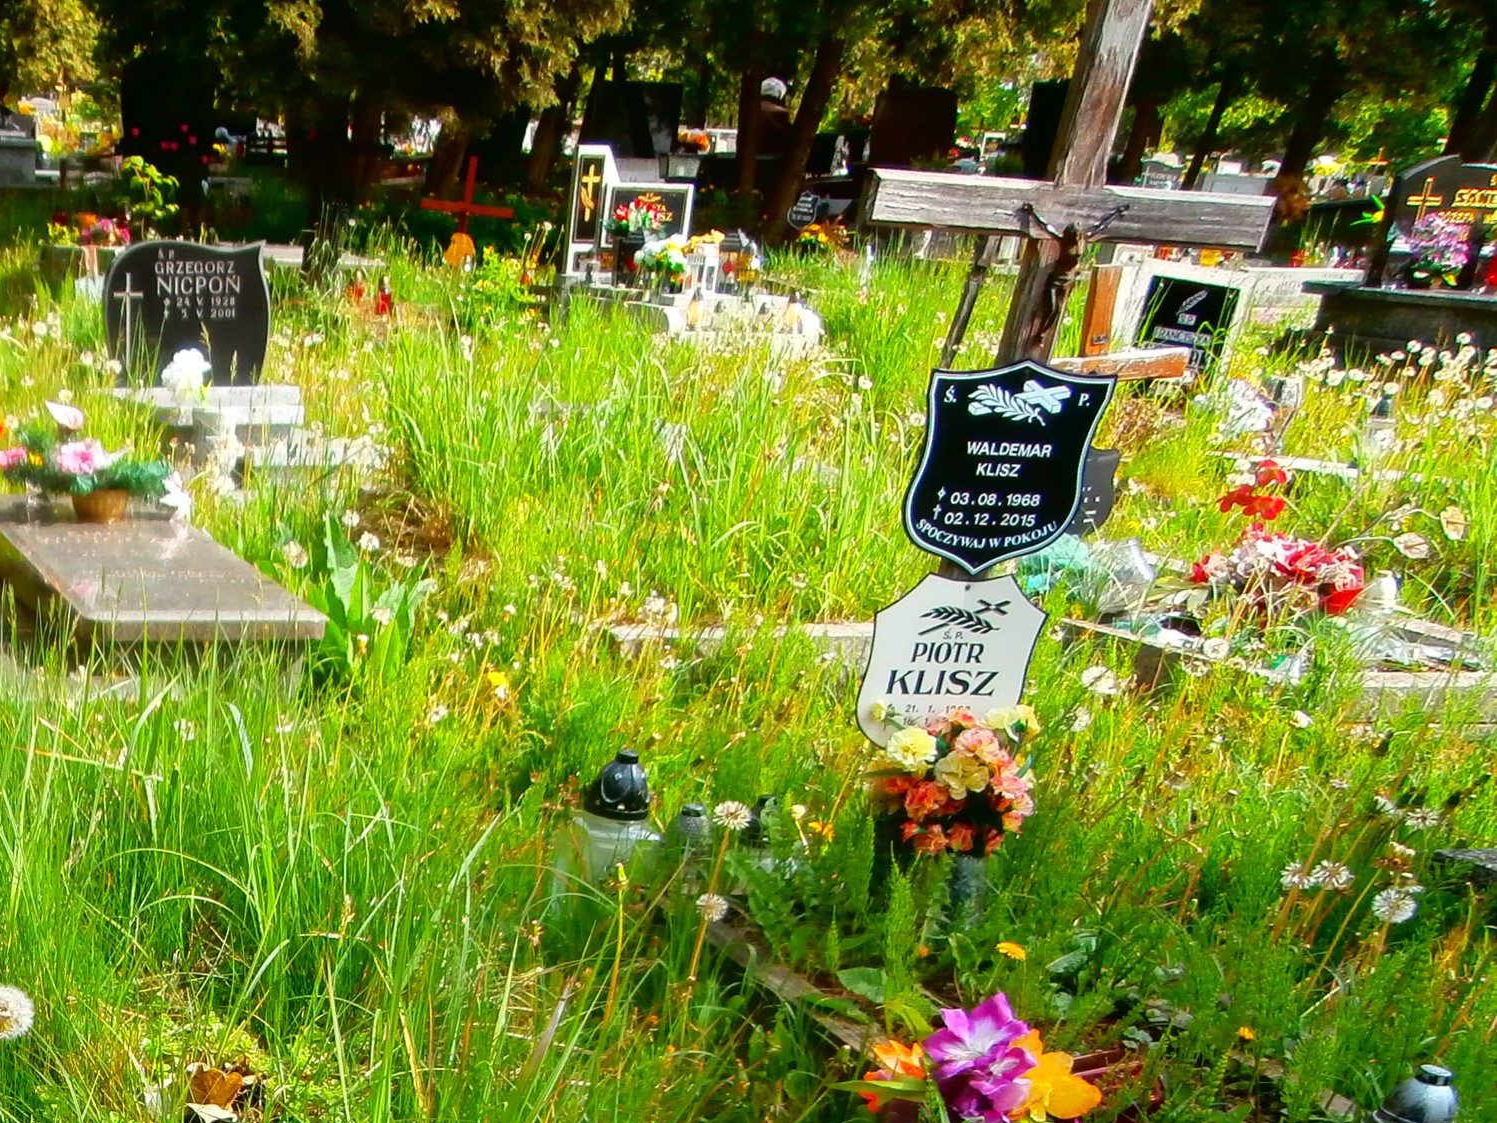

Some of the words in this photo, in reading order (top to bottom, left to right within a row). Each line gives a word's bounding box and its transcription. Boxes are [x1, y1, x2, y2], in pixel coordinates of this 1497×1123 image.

[154, 260, 235, 275] GRZEGORZ
[156, 275, 240, 296] NICPOŃ
[967, 441, 1052, 457] WALDEMAR
[975, 463, 1022, 477] KLISZ
[915, 518, 987, 549] SPOCZYWAJ
[989, 537, 1002, 548] W
[1003, 521, 1058, 547] POKOJU
[910, 641, 985, 664] PIOTR
[885, 669, 1000, 697] KLISZ
